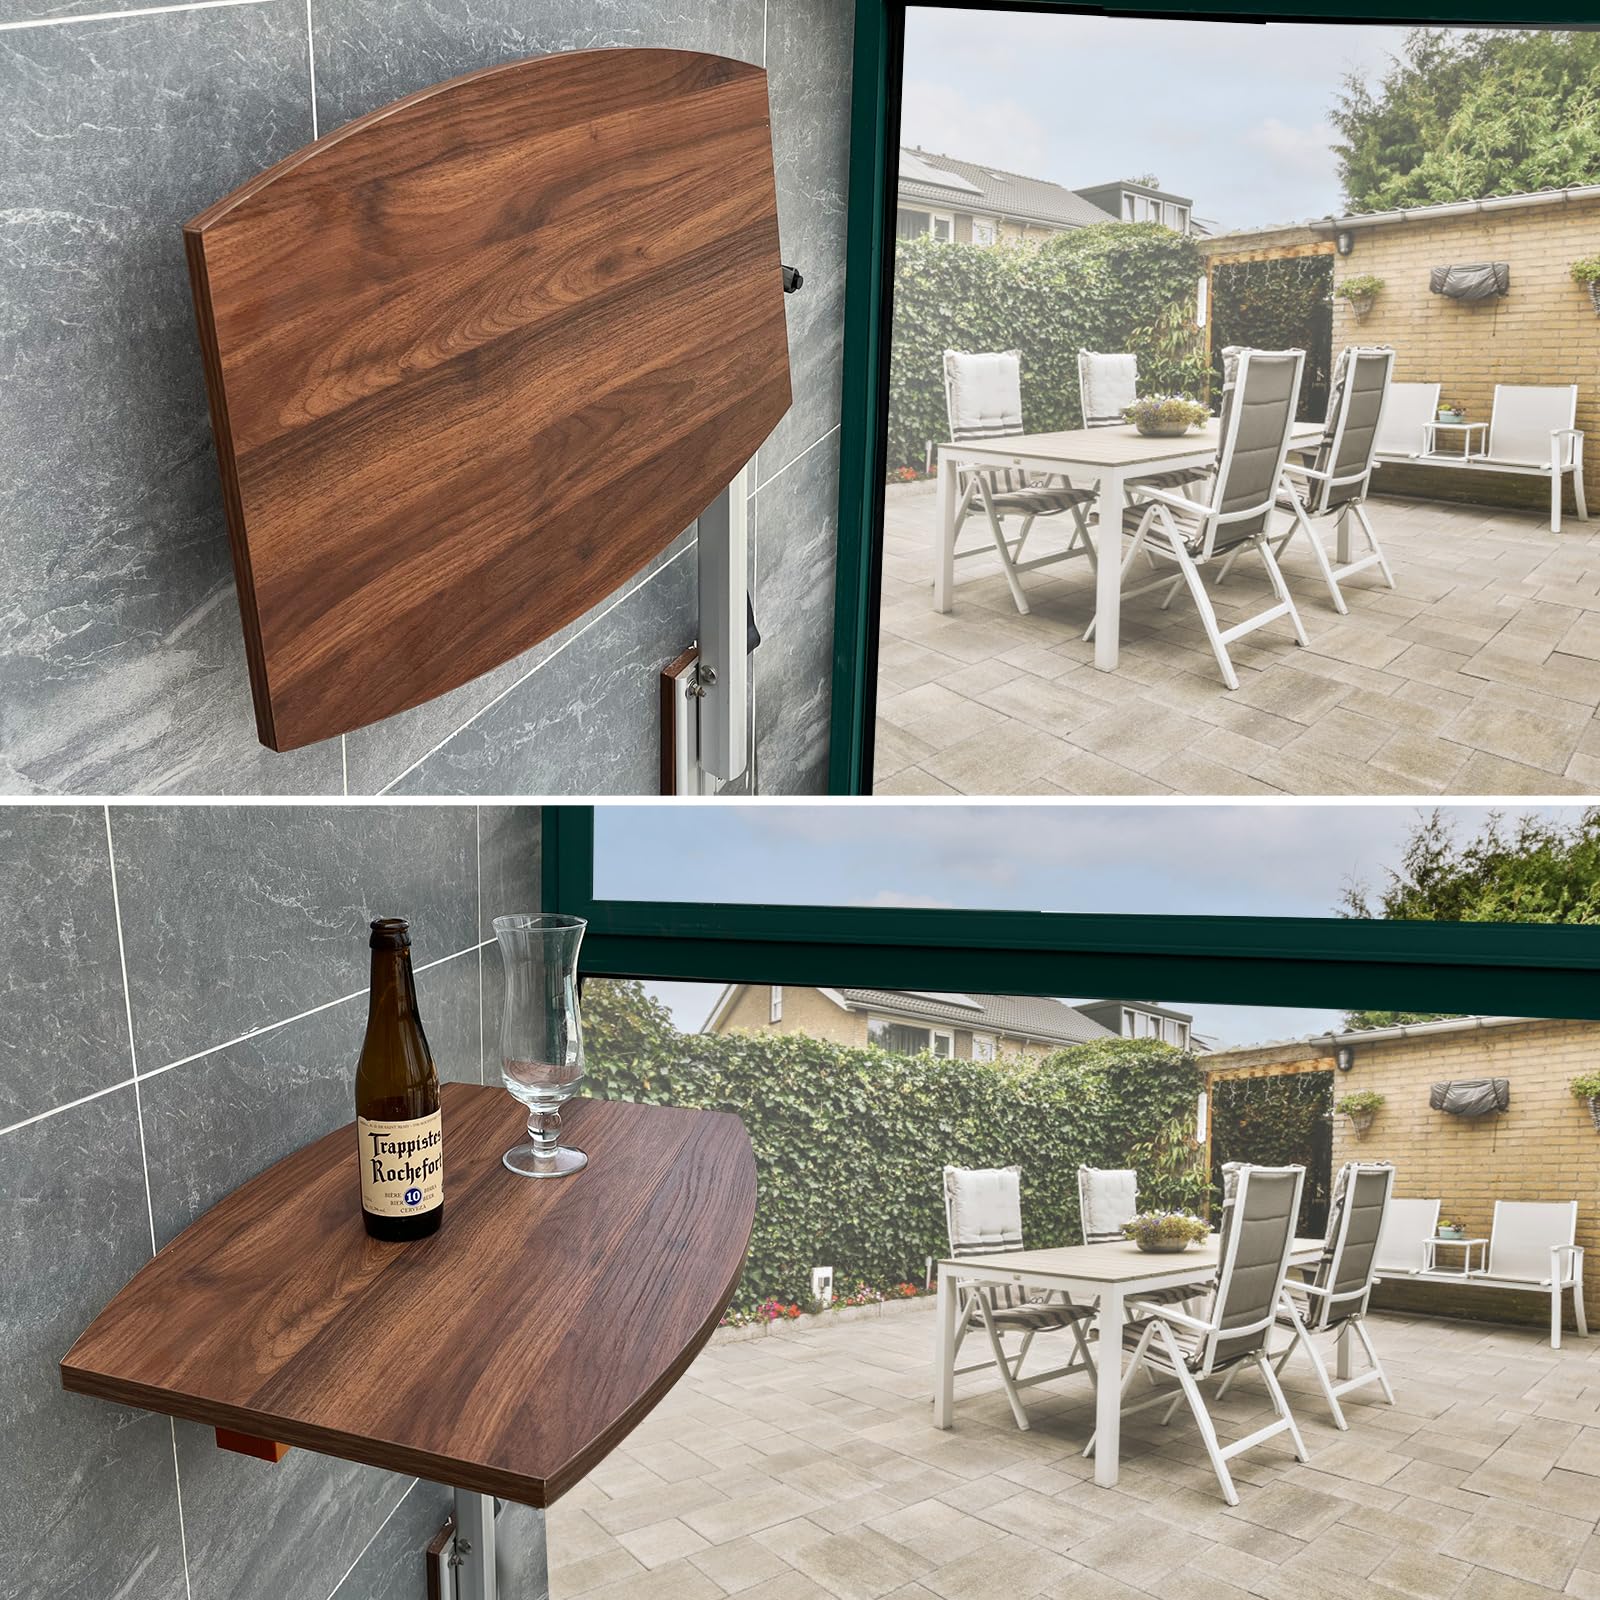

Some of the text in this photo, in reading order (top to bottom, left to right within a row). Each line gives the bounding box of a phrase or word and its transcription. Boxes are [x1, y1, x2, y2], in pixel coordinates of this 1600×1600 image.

[368, 1130, 441, 1159] Trappistes
[406, 1190, 421, 1203] 10
[400, 1204, 427, 1214] CERVEZA
